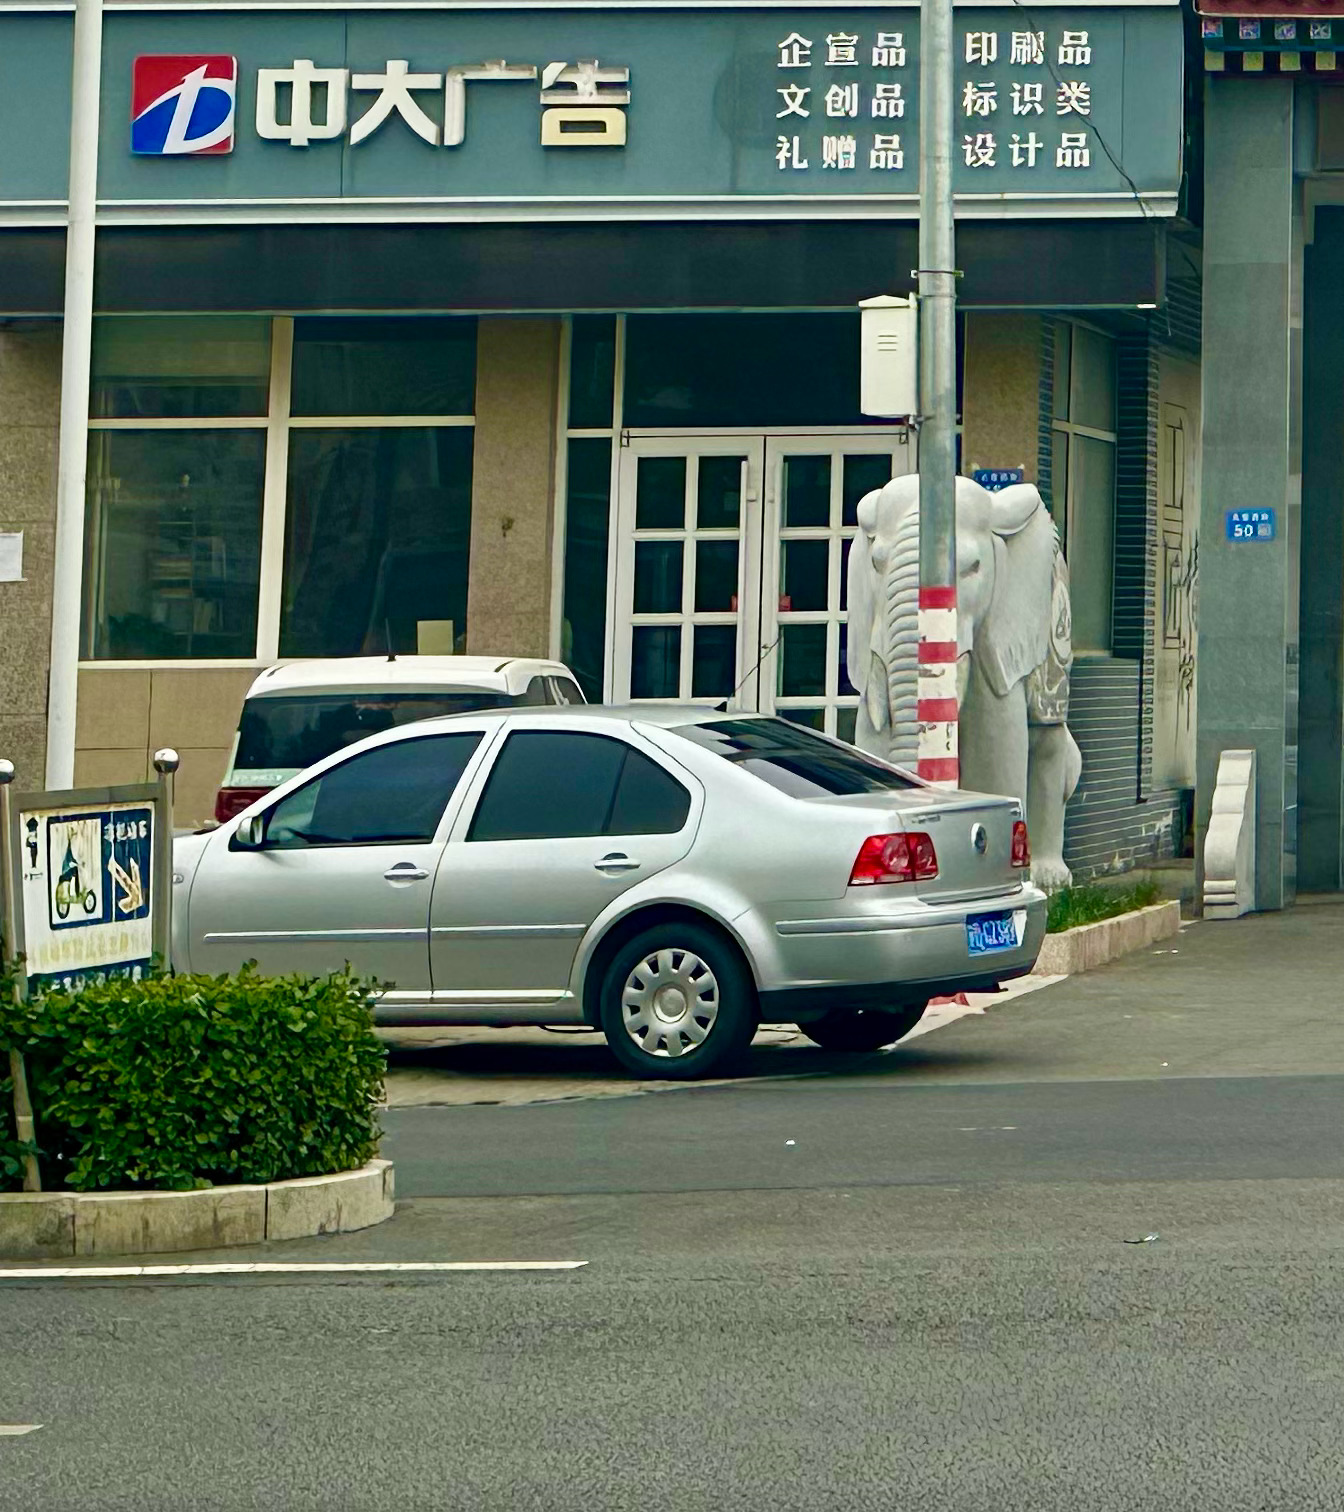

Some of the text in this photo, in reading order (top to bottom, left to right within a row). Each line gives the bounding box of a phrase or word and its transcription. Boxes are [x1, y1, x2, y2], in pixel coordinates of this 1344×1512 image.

[777, 30, 1092, 68] 企宣品 印刷品
[256, 59, 631, 147] 中大广告
[776, 80, 1091, 119] 文创品 标识类
[775, 133, 1091, 170] 礼赠品 设计品
